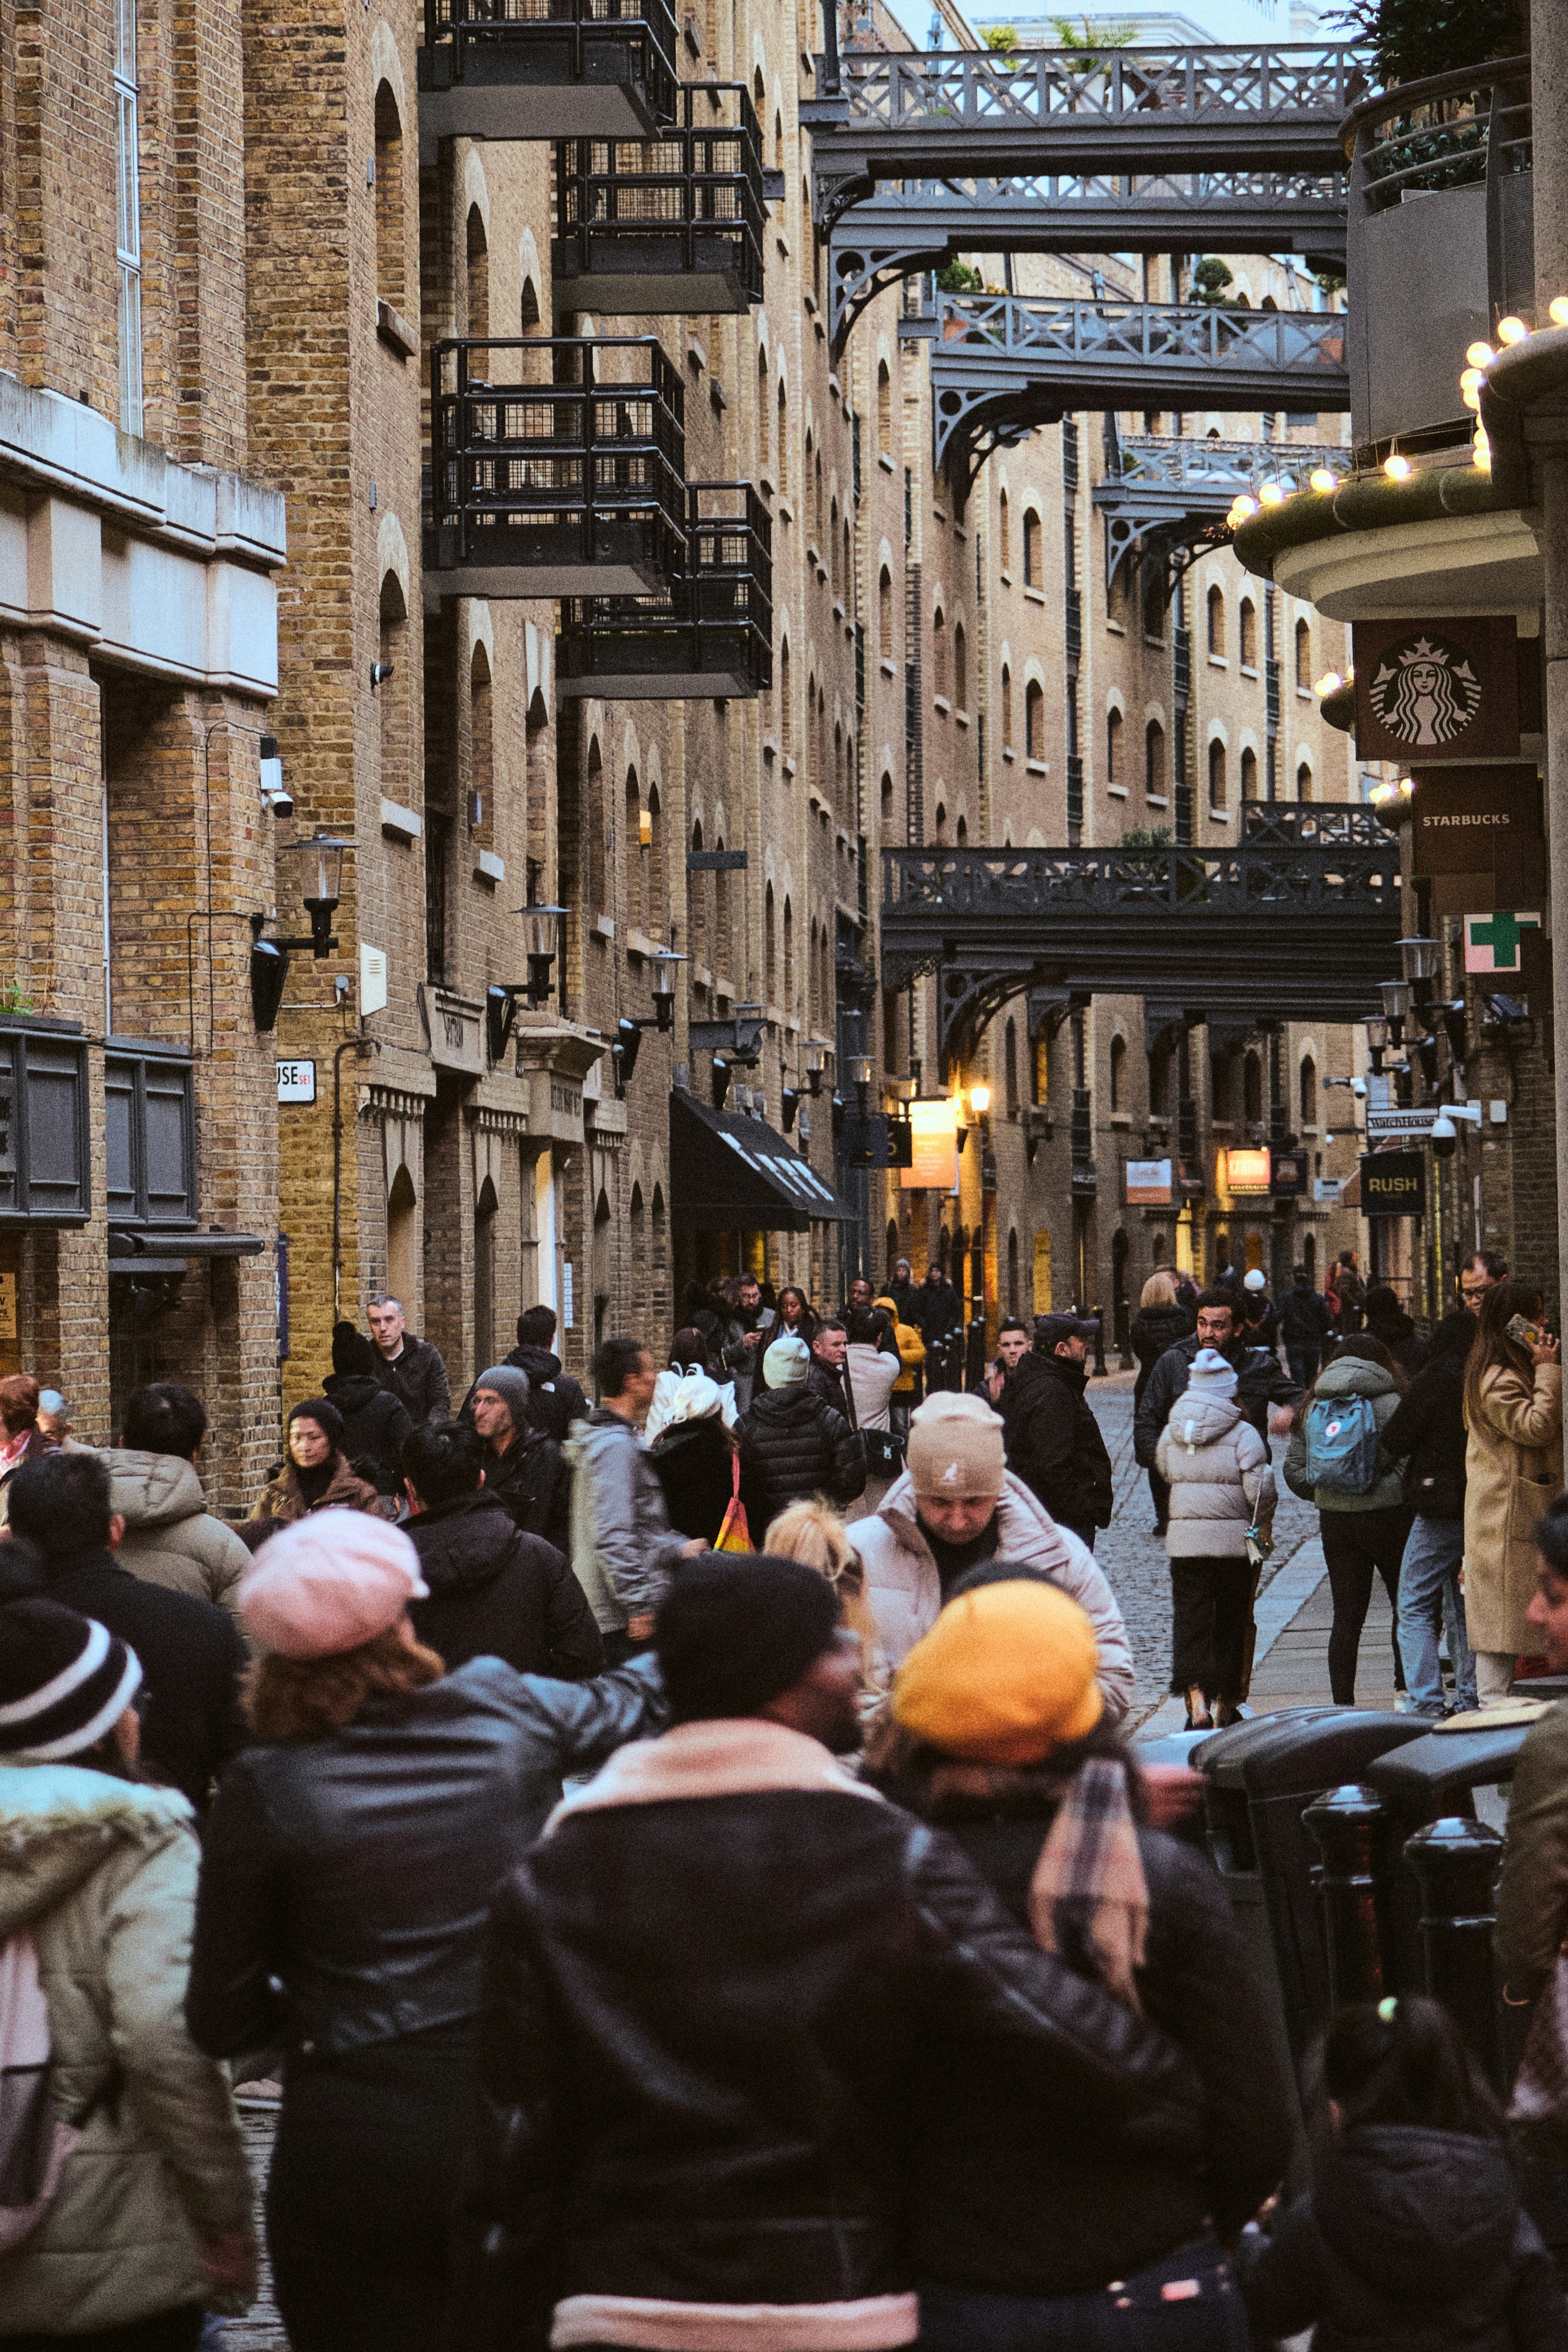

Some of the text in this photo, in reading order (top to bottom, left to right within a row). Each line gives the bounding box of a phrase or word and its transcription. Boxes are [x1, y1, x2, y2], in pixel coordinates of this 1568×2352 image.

[1422, 813, 1510, 827] STARBUCKS
[299, 1075, 311, 1085] SE1
[1369, 1177, 1418, 1192] RUSH
